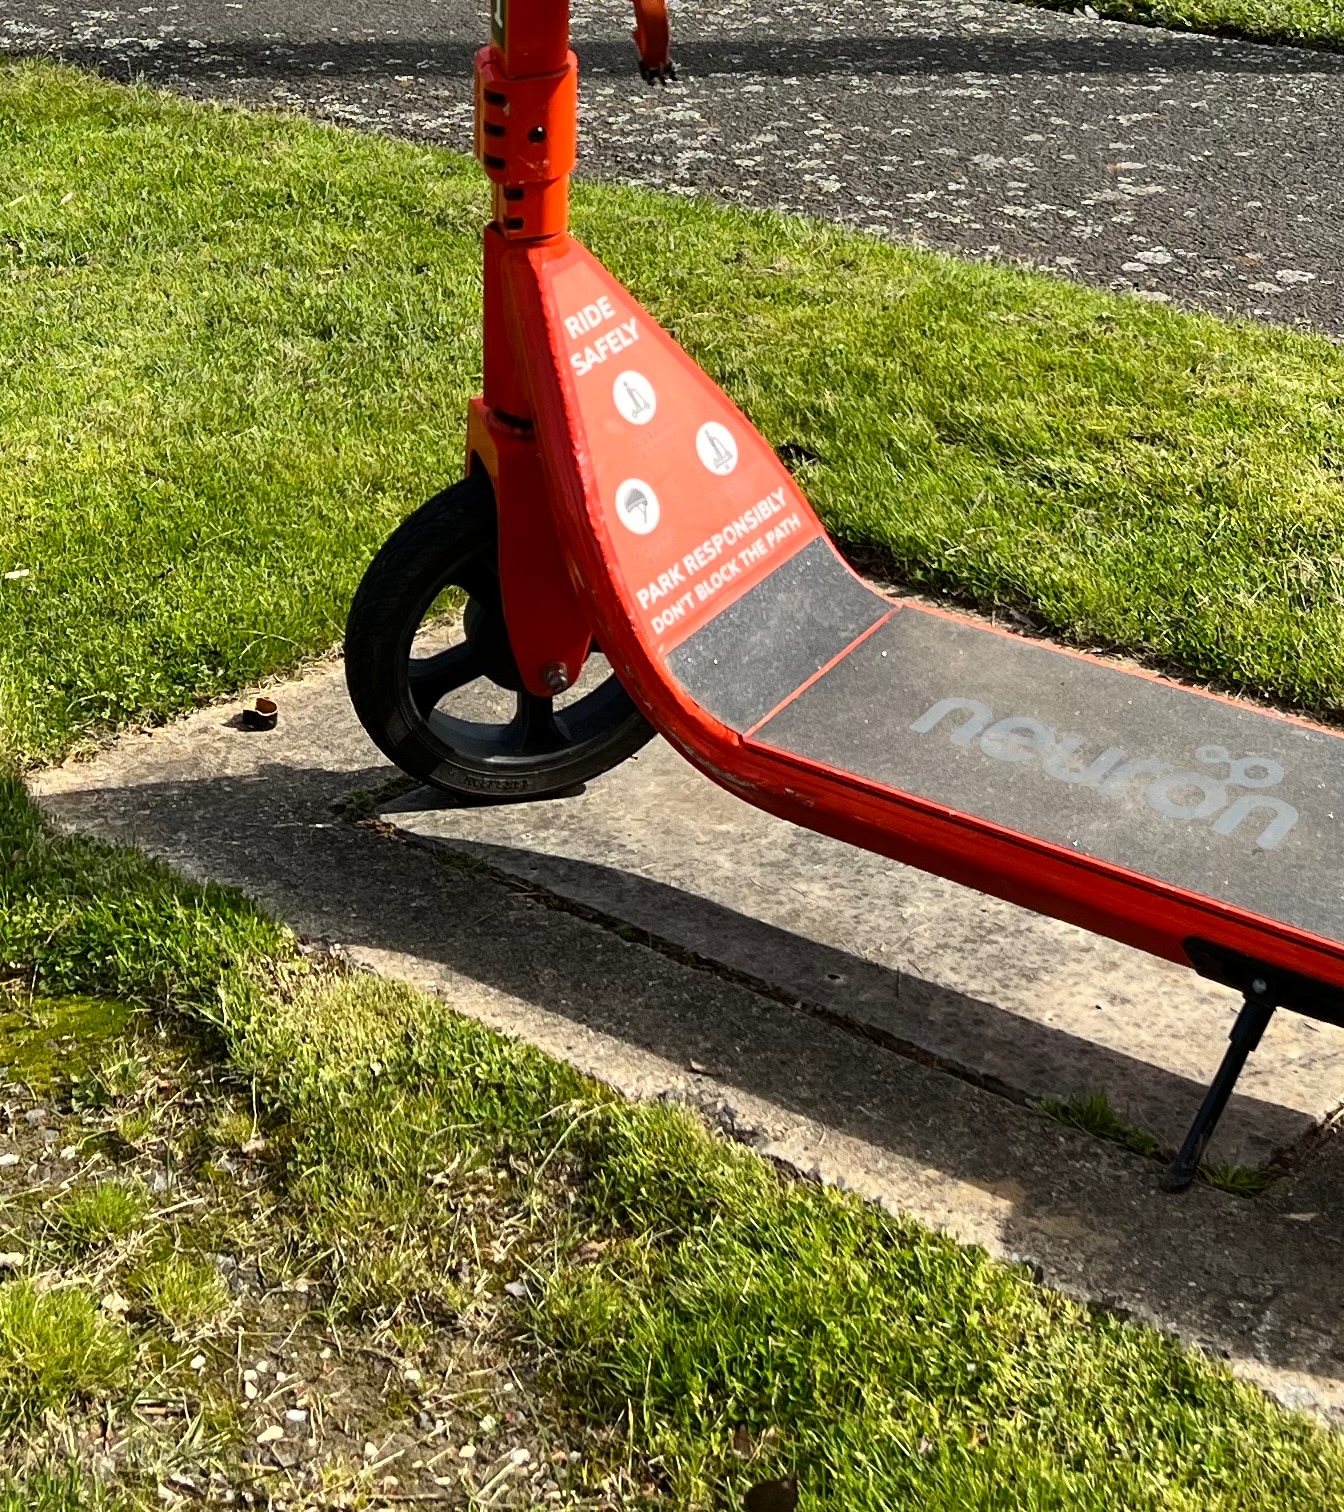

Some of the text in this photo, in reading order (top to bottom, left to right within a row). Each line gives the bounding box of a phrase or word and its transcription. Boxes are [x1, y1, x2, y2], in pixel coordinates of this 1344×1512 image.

[563, 295, 615, 340] RIDE
[569, 316, 639, 376] SAFELY
[636, 486, 787, 611] PARK RESPONSIBLY
[650, 512, 802, 635] DON'T BLOCK THE PATH
[910, 696, 1299, 850] neuron
